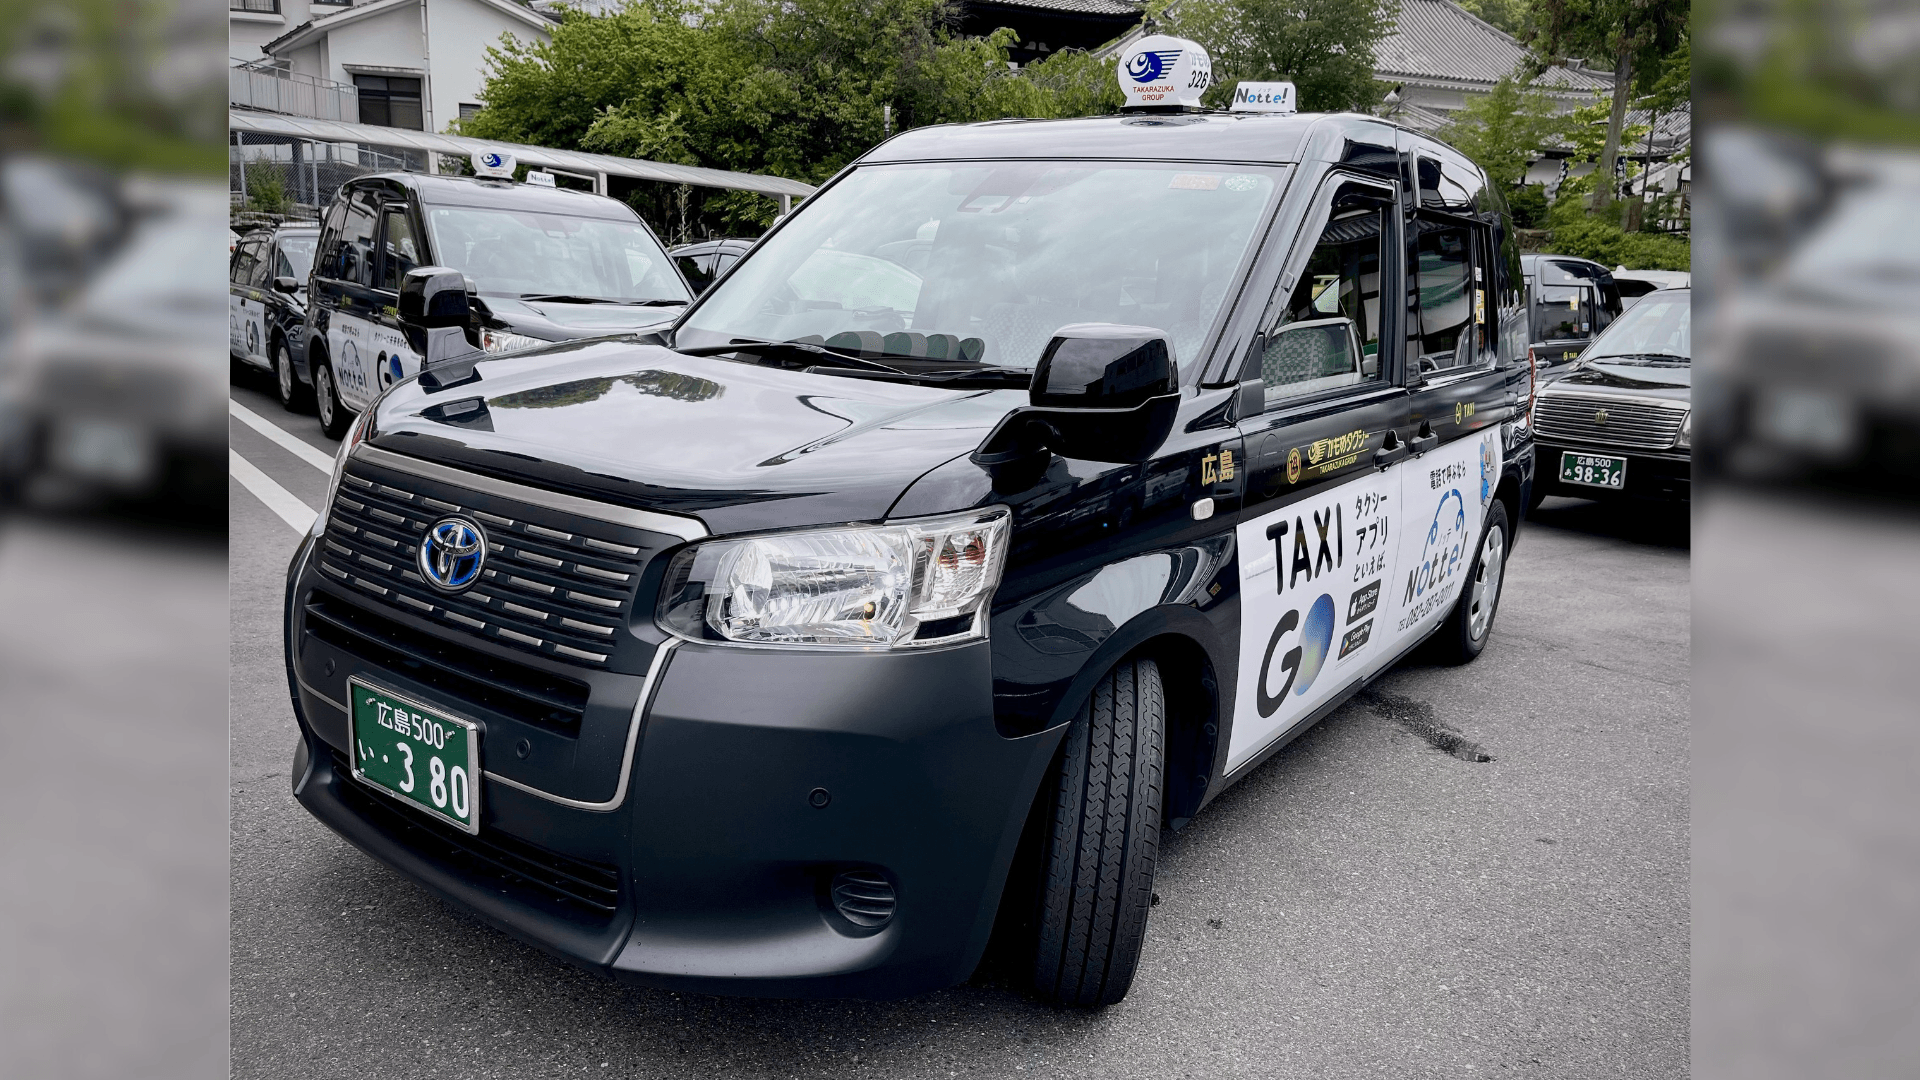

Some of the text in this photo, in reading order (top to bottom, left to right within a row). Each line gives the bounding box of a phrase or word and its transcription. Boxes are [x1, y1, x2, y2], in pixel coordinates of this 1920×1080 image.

[1188, 70, 1209, 89] 326
[1235, 87, 1288, 104] Notte!
[1464, 402, 1475, 418] TAXI
[1327, 429, 1369, 458] かもめタクシー
[1202, 450, 1235, 487] 広島
[1430, 460, 1466, 489] 電話で呼ぶなら
[1574, 465, 1621, 486] 98-36
[1355, 492, 1387, 520] タクシー
[1266, 503, 1343, 595] TAXI
[1356, 516, 1388, 556] アプリ
[1402, 531, 1468, 608] Notte!
[1257, 593, 1335, 719] GO
[358, 738, 375, 761] い
